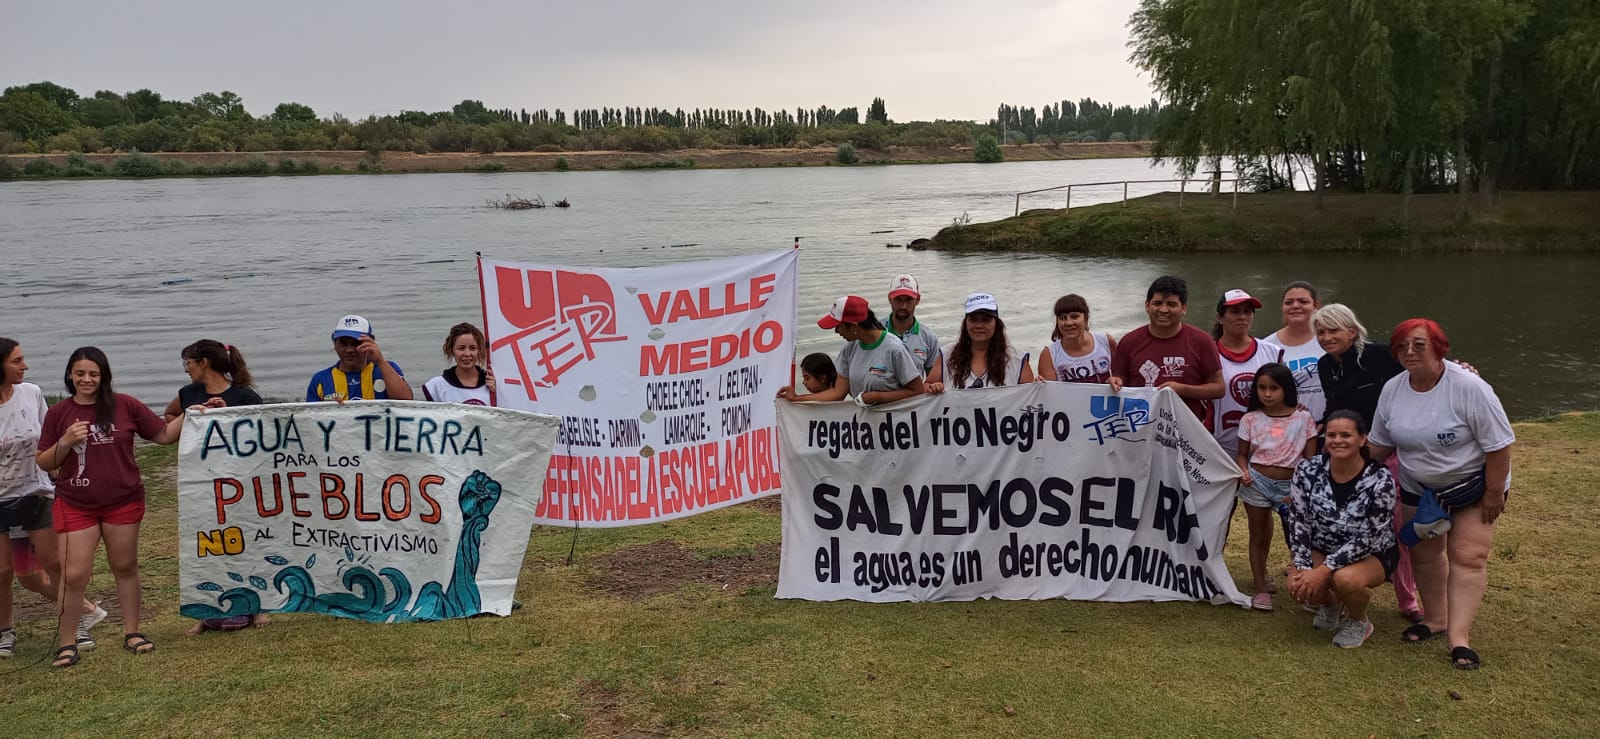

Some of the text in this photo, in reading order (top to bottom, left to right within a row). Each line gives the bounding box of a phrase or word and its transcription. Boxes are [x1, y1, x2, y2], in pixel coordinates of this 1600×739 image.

[637, 273, 776, 325] VALLE
[639, 320, 783, 376] MEDIO
[646, 380, 678, 411] CHOELE
[679, 378, 705, 409] CHOEL
[727, 364, 759, 399] BELTRAN
[201, 414, 304, 460] AGUA
[317, 420, 336, 452] Y
[566, 415, 601, 448] BELISLE
[608, 418, 641, 448] DARWIN
[664, 411, 706, 446] LAMARQUE
[721, 402, 752, 438] POMONA
[808, 406, 1070, 459] regata del río Negro
[274, 452, 361, 468] PARA LOS
[213, 472, 445, 524] PUEBLOS
[812, 476, 1074, 537] SALVEMOS
[1079, 476, 1140, 531] EL
[197, 526, 245, 557] NO
[254, 527, 275, 542] AL
[815, 536, 840, 584] el
[853, 551, 916, 593] agua
[918, 551, 946, 588] es
[952, 549, 983, 586] un
[999, 528, 1118, 582] derecho
